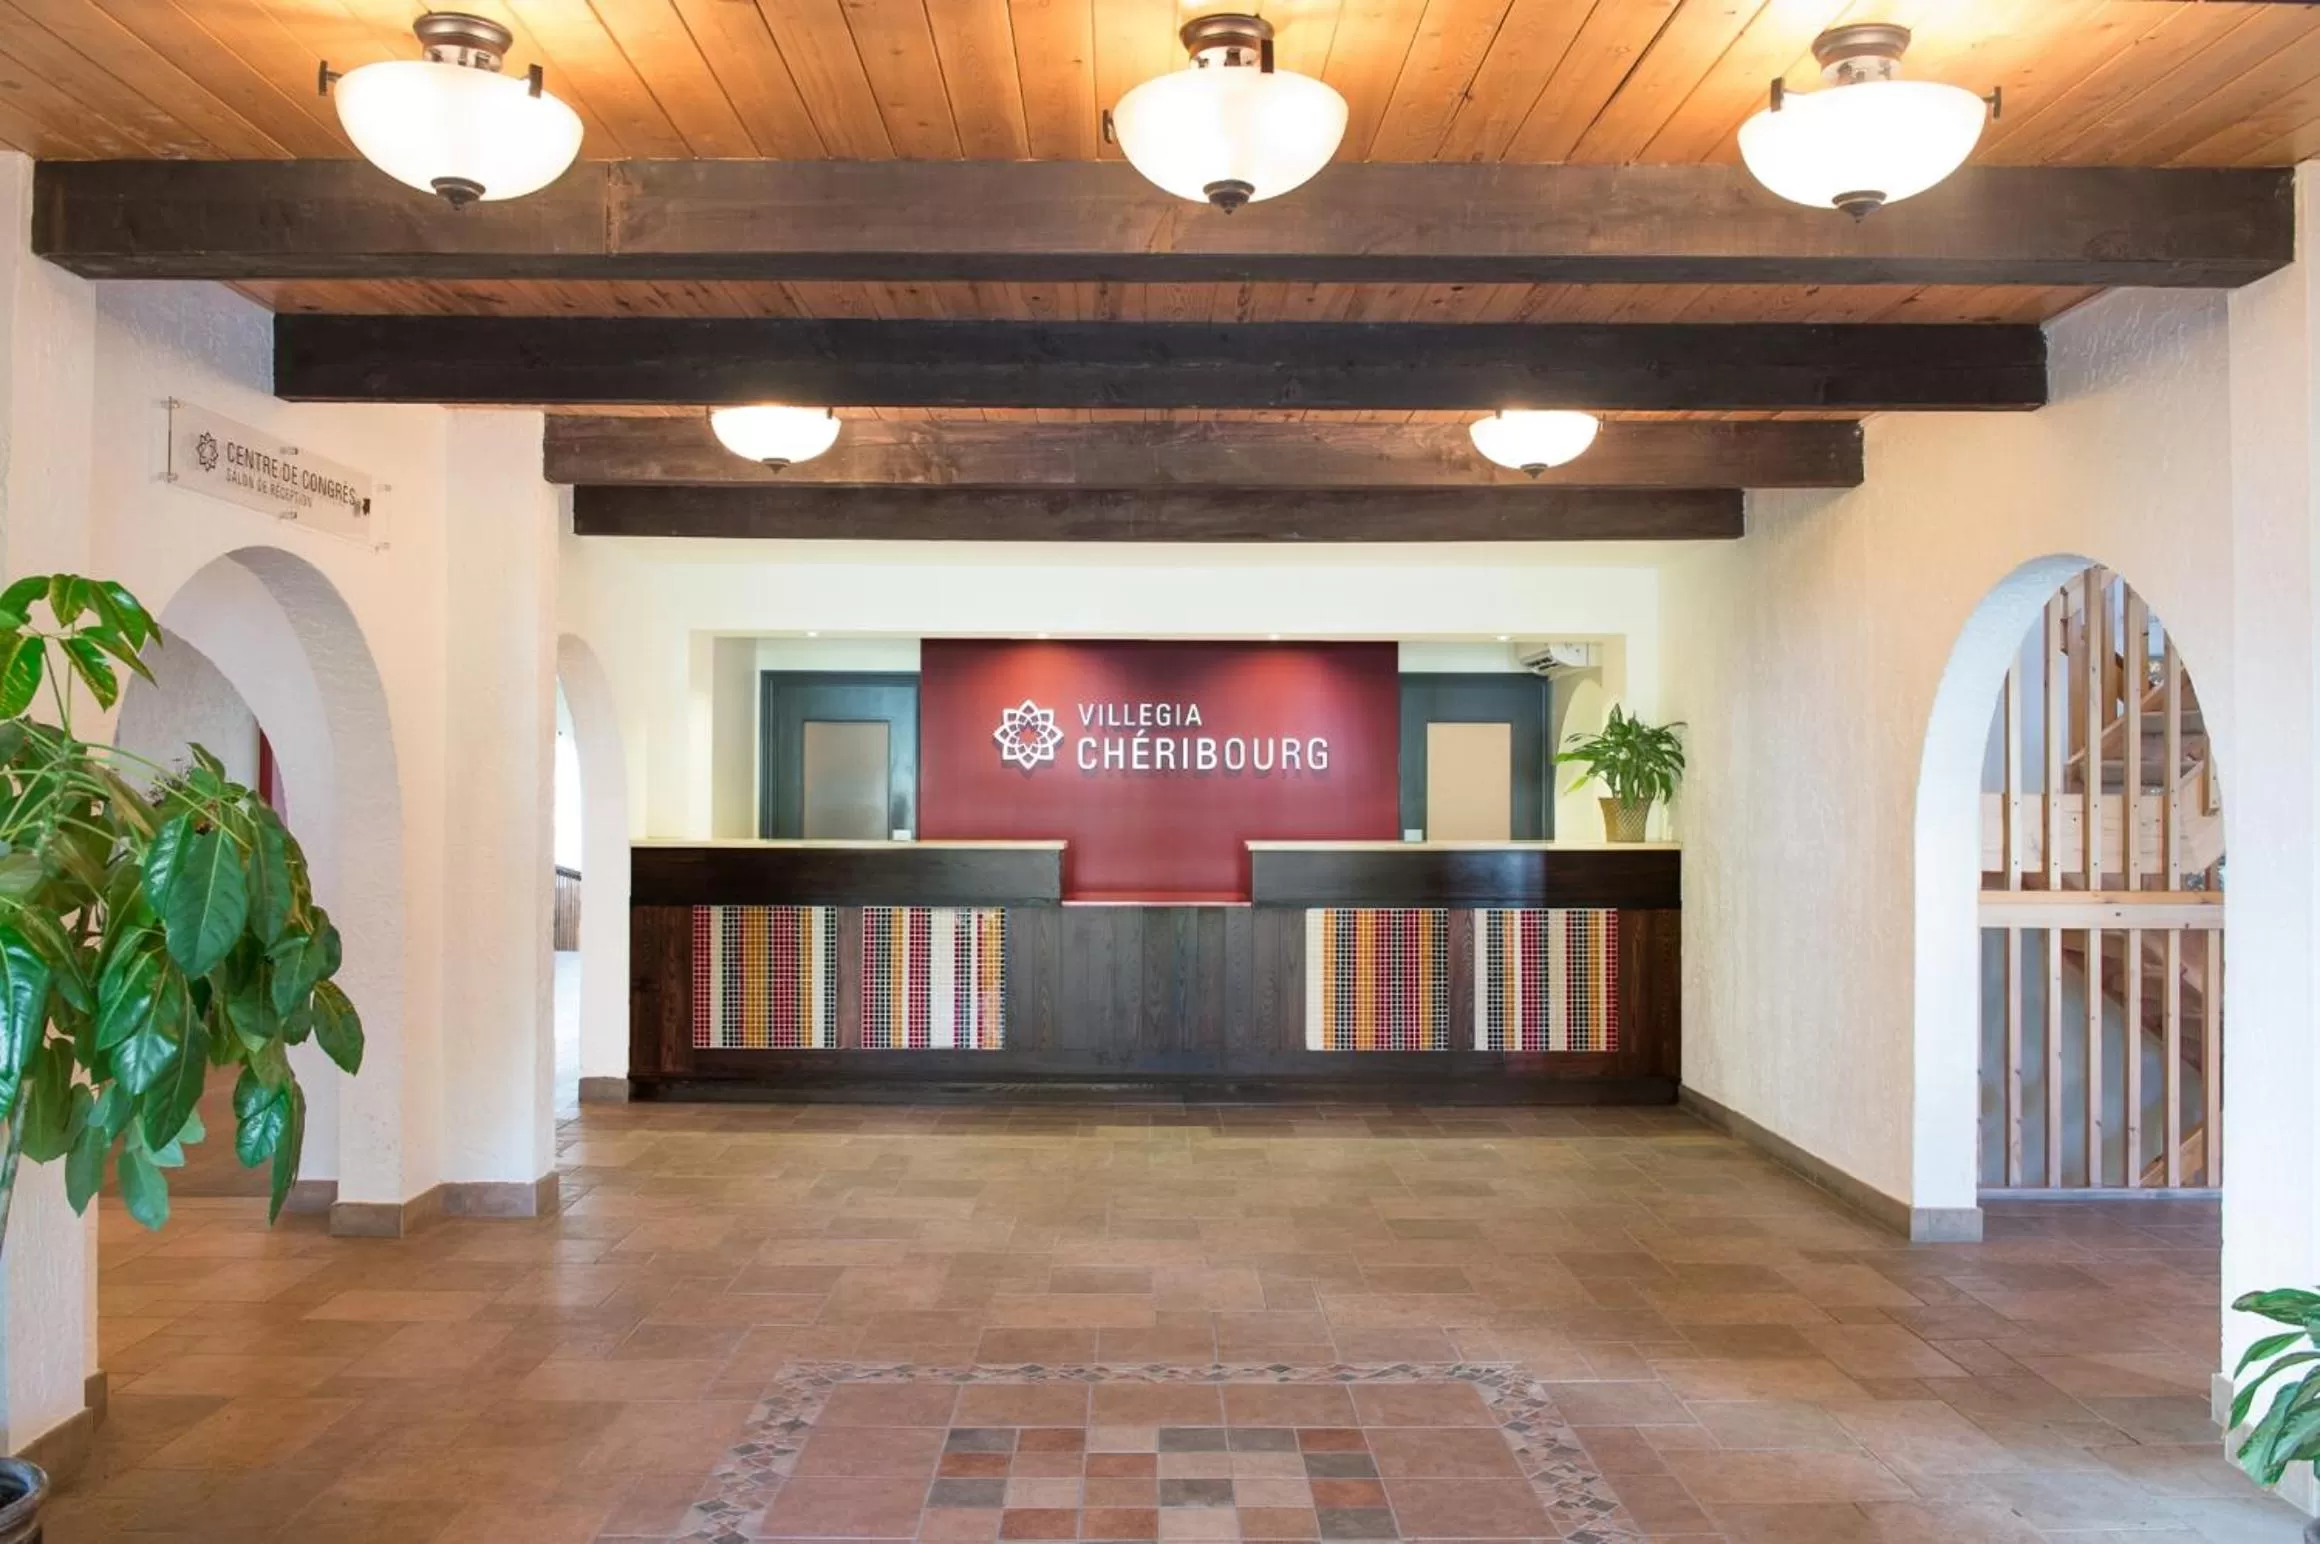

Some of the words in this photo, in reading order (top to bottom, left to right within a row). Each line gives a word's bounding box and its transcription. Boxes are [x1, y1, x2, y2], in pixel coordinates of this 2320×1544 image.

[226, 442, 279, 477] CENTRE
[282, 463, 299, 486] DE
[226, 467, 255, 489] SALON
[257, 479, 268, 494] DE
[1077, 703, 1203, 727] VILLEGIA
[1077, 729, 1329, 770] CHÉRIBOURG
